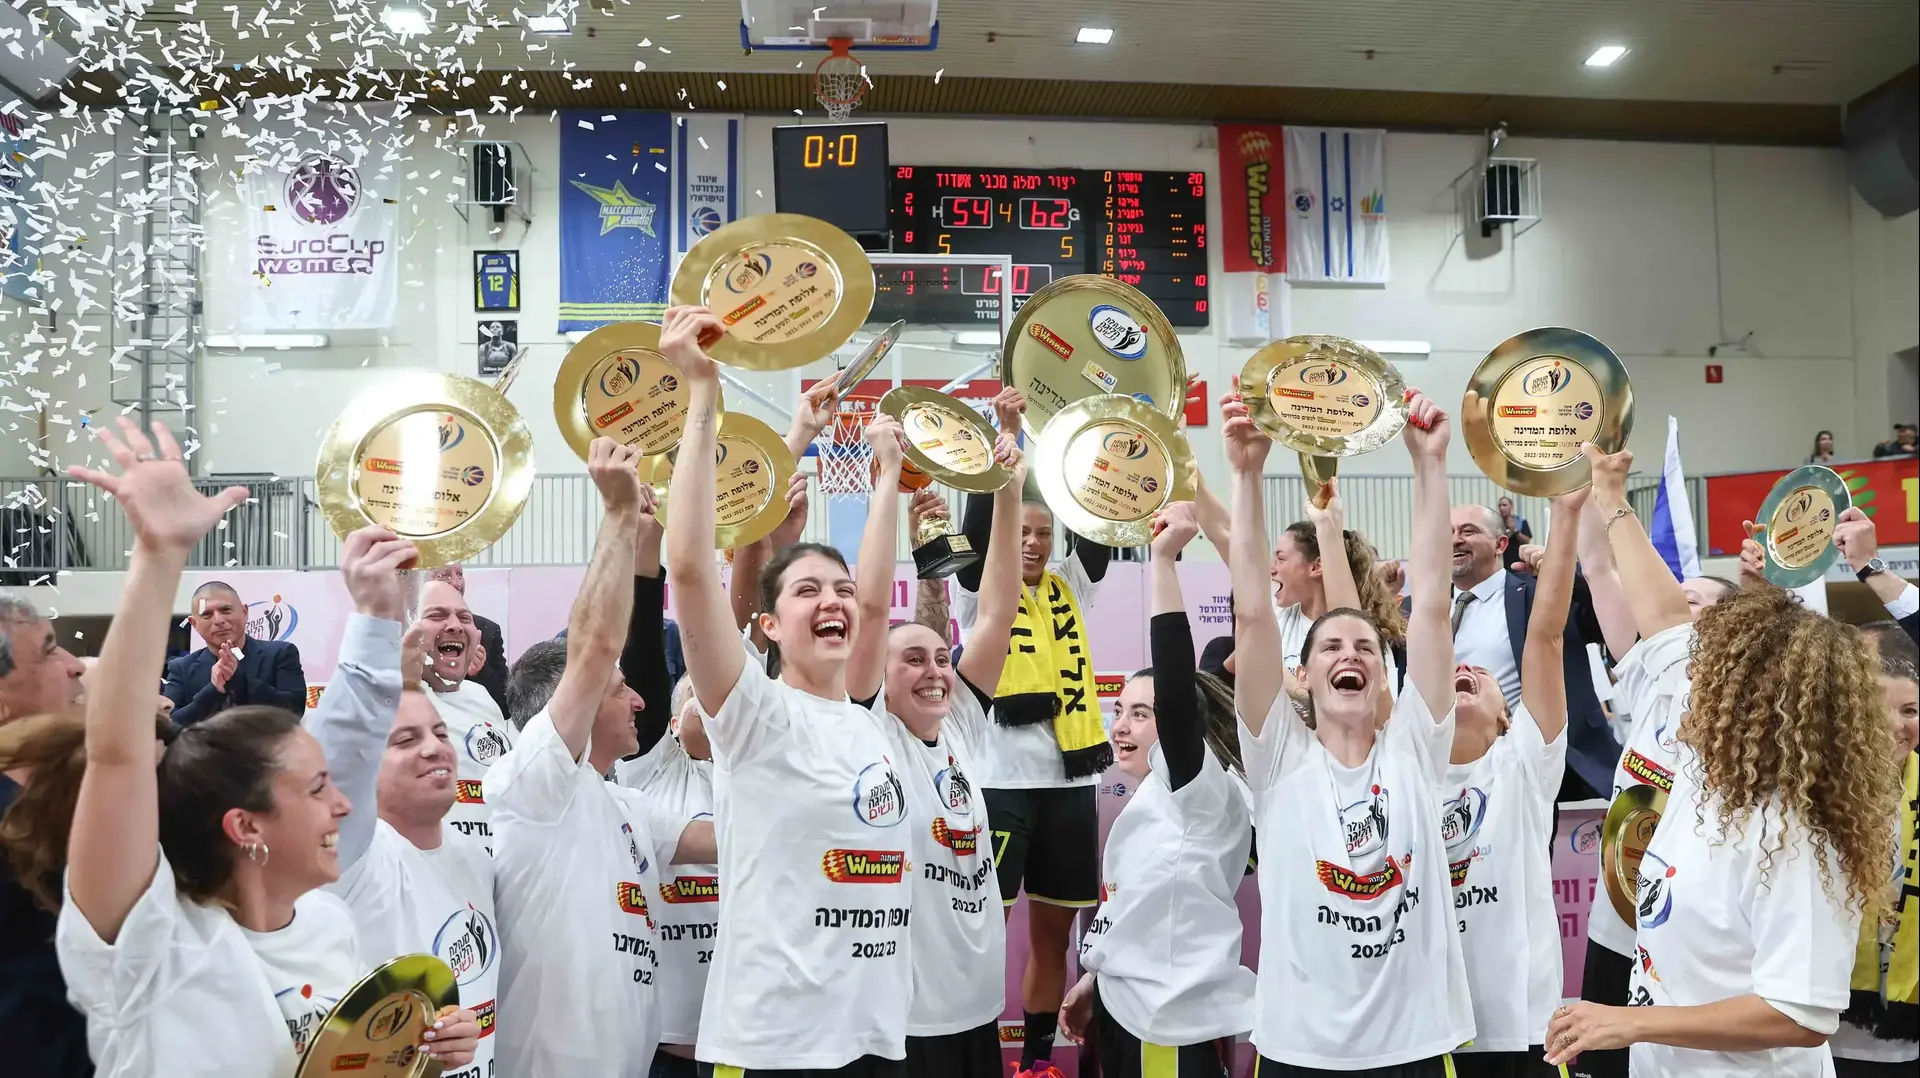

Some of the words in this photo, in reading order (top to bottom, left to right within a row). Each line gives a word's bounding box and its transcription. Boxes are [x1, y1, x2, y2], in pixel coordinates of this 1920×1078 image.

[804, 134, 857, 167] 0:0
[897, 167, 913, 178] 20
[1104, 171, 1112, 182] 0
[1187, 173, 1203, 184] 20
[697, 175, 718, 184] איגוד
[936, 173, 971, 188] אשדוד
[980, 174, 1007, 189] מכבי
[690, 184, 725, 194] הכדורסל
[1108, 184, 1112, 194] 1
[1192, 186, 1204, 196] 13
[690, 194, 725, 203] הישראלי
[905, 193, 913, 204] 2
[1105, 197, 1113, 207] 2
[905, 206, 913, 216] 4
[932, 206, 943, 218] H
[953, 199, 990, 226] 54
[1000, 203, 1012, 222] 4
[1031, 200, 1069, 227] 62
[1068, 208, 1080, 221] G
[1106, 210, 1113, 219] 4
[1246, 162, 1271, 267] Winner
[1107, 222, 1113, 232] 7
[1193, 224, 1205, 234] 14
[905, 231, 913, 243] 8
[1105, 235, 1113, 245] 8
[1197, 236, 1205, 248] 5
[258, 234, 384, 262] EuroCup
[938, 234, 951, 254] 5
[1061, 237, 1073, 258] 5
[1106, 248, 1114, 258] 9
[259, 259, 373, 273] women
[1103, 261, 1114, 271] 15
[488, 275, 504, 292] 12
[1195, 275, 1206, 286] 10
[789, 285, 818, 307] אלופת
[1195, 300, 1207, 312] 10
[754, 303, 788, 328] המדינה
[1040, 328, 1070, 357] Winner
[1029, 377, 1067, 409] מדינה
[1282, 388, 1312, 398] Winner
[652, 400, 677, 419] אלופת
[1291, 404, 1322, 414] המדינה
[1327, 407, 1354, 417] אלופת
[1505, 407, 1535, 416] Winner
[622, 415, 651, 435] המדינה
[1514, 426, 1545, 435] המדינה
[1549, 425, 1577, 435] אלופת
[376, 461, 404, 472] Winn
[732, 481, 755, 494] אלופת
[1112, 485, 1139, 502] אלופת
[1212, 596, 1232, 604] איגוד
[1199, 605, 1232, 613] הכדורסל
[245, 617, 264, 629] מנהל
[1199, 615, 1233, 623] הישראלי
[1096, 683, 1121, 692] ner
[1628, 755, 1673, 791] Winner
[870, 781, 891, 798] מנהלת
[868, 791, 894, 809] הליגה
[869, 803, 894, 820] נשים
[990, 831, 1010, 867] 7
[1331, 867, 1396, 894] Winner
[676, 879, 719, 896] Winn
[1455, 885, 1498, 909] אלופ
[815, 907, 885, 928] המדינה
[448, 931, 471, 958] מנהלת
[852, 941, 897, 958] 2022/23
[450, 943, 474, 969] הליגה
